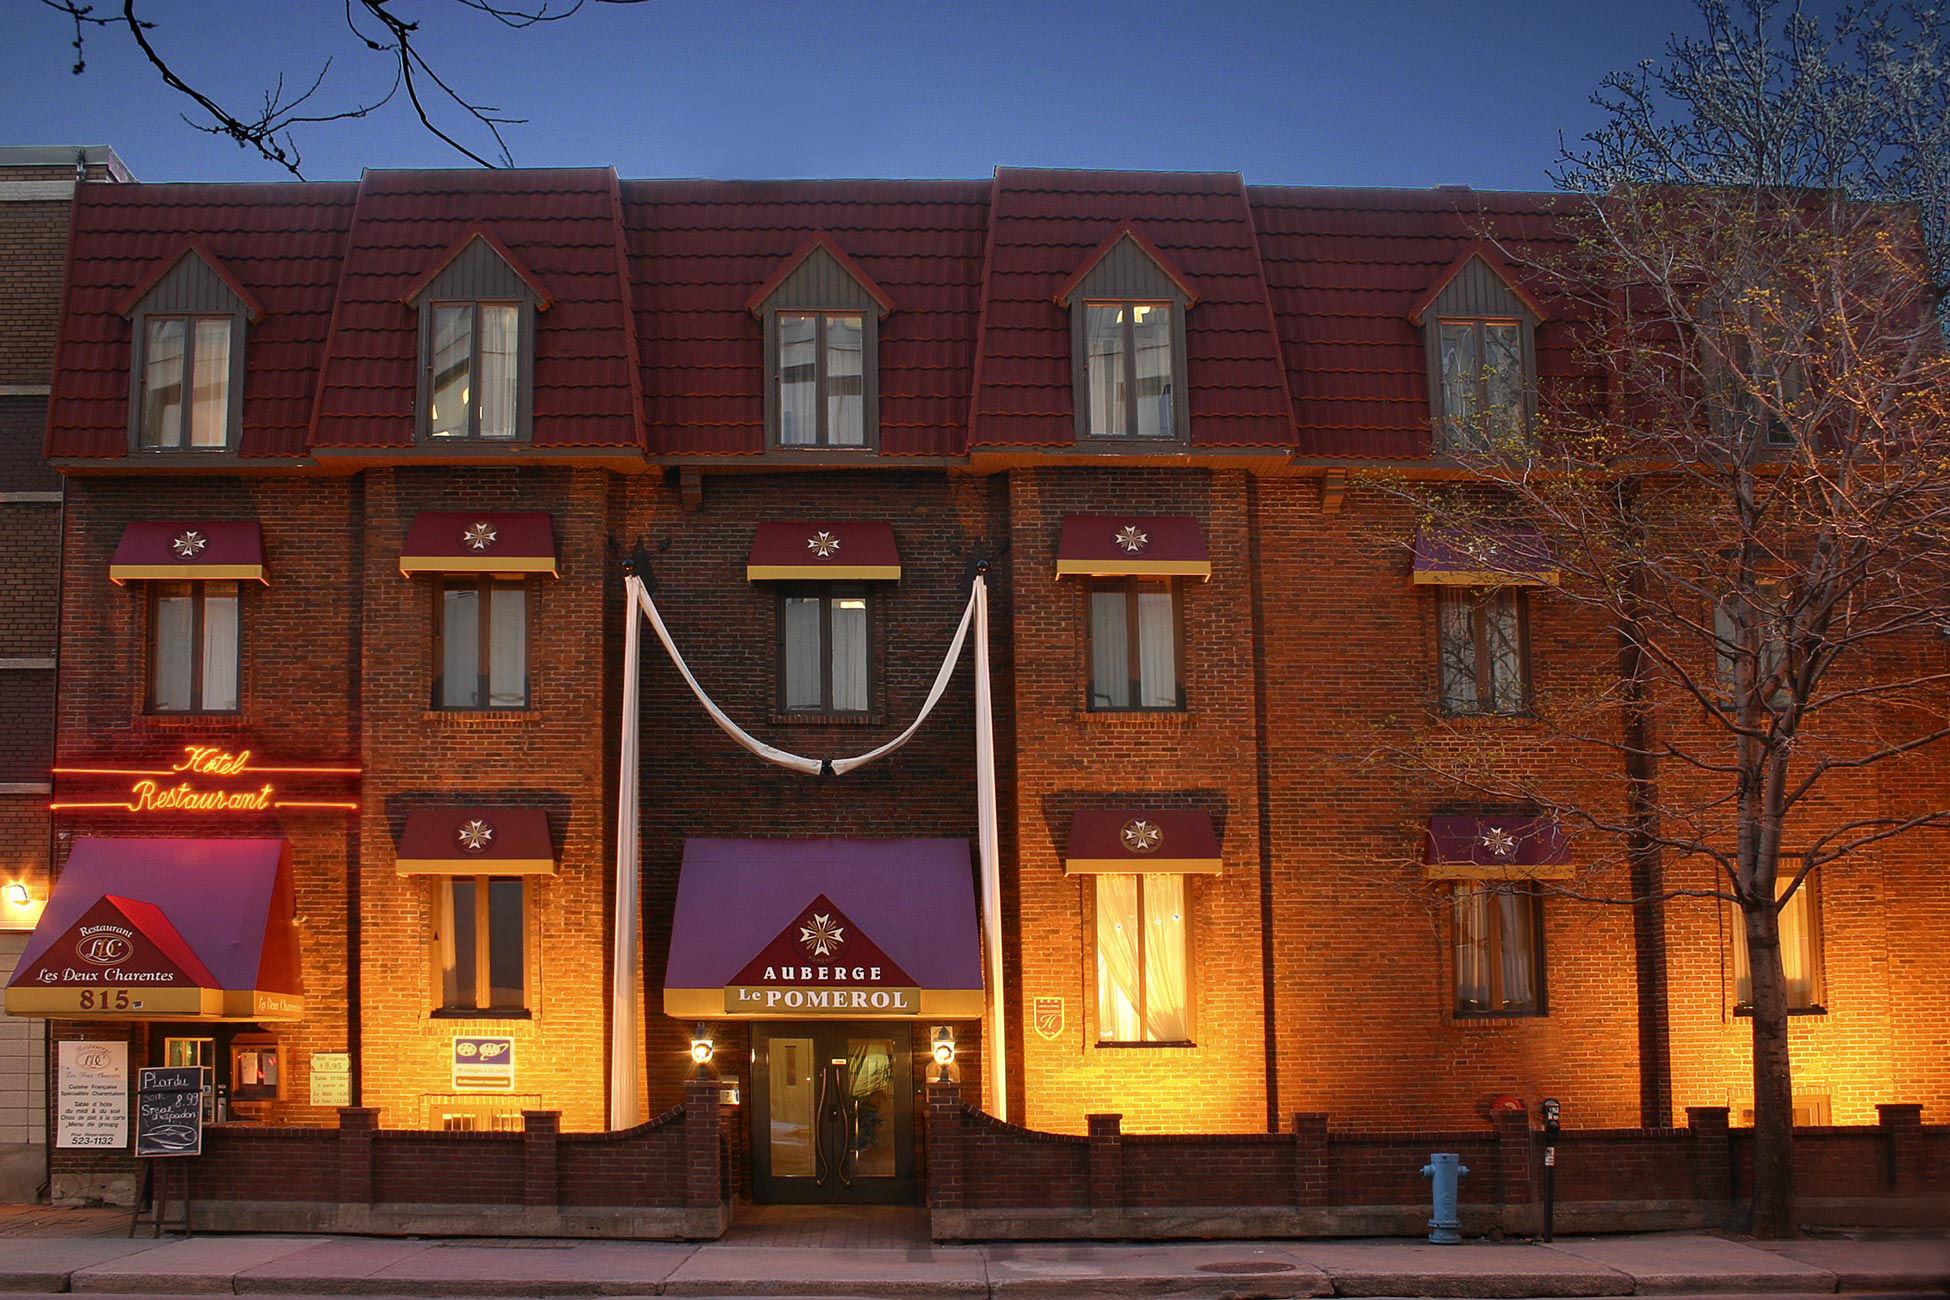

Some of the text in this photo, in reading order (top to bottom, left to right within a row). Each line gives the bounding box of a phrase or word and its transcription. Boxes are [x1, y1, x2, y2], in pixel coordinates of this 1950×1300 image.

[127, 780, 273, 812] Restaurant
[79, 924, 134, 939] Restaurant
[36, 966, 174, 983] Les Deux Charentes
[763, 966, 881, 980] AUBERGE
[79, 989, 130, 1010] 815
[738, 988, 908, 1009] Le POMEROL
[71, 1136, 114, 1145] 523-1132
